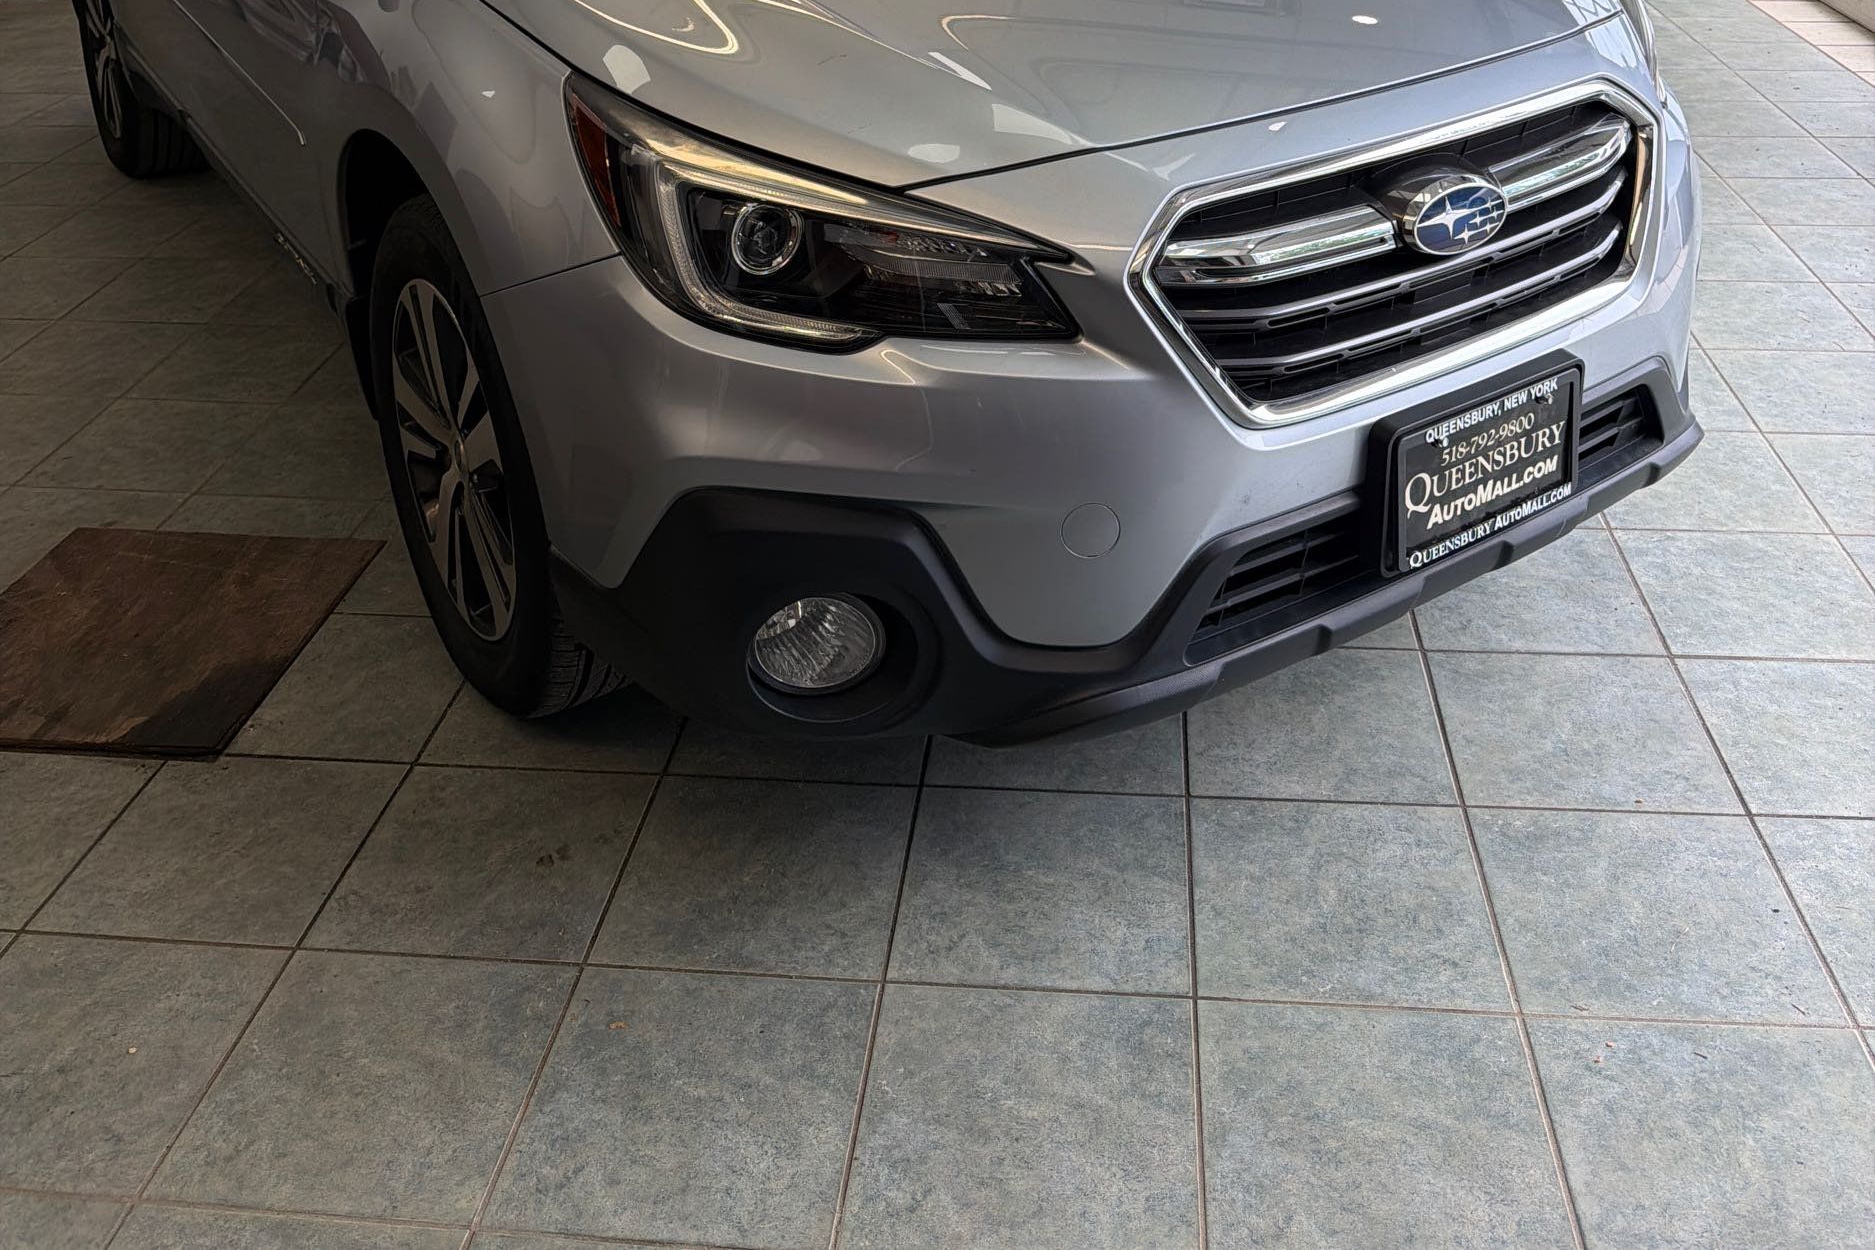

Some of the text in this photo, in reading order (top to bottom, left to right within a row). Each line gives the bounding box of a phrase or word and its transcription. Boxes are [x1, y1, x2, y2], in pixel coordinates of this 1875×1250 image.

[1425, 378, 1558, 443] QUEENSBURY, NEW YORK
[1441, 412, 1535, 466] 518-792-9800
[1405, 421, 1566, 519] QUEENSBURY
[1409, 518, 1496, 569] QUEENSBURY
